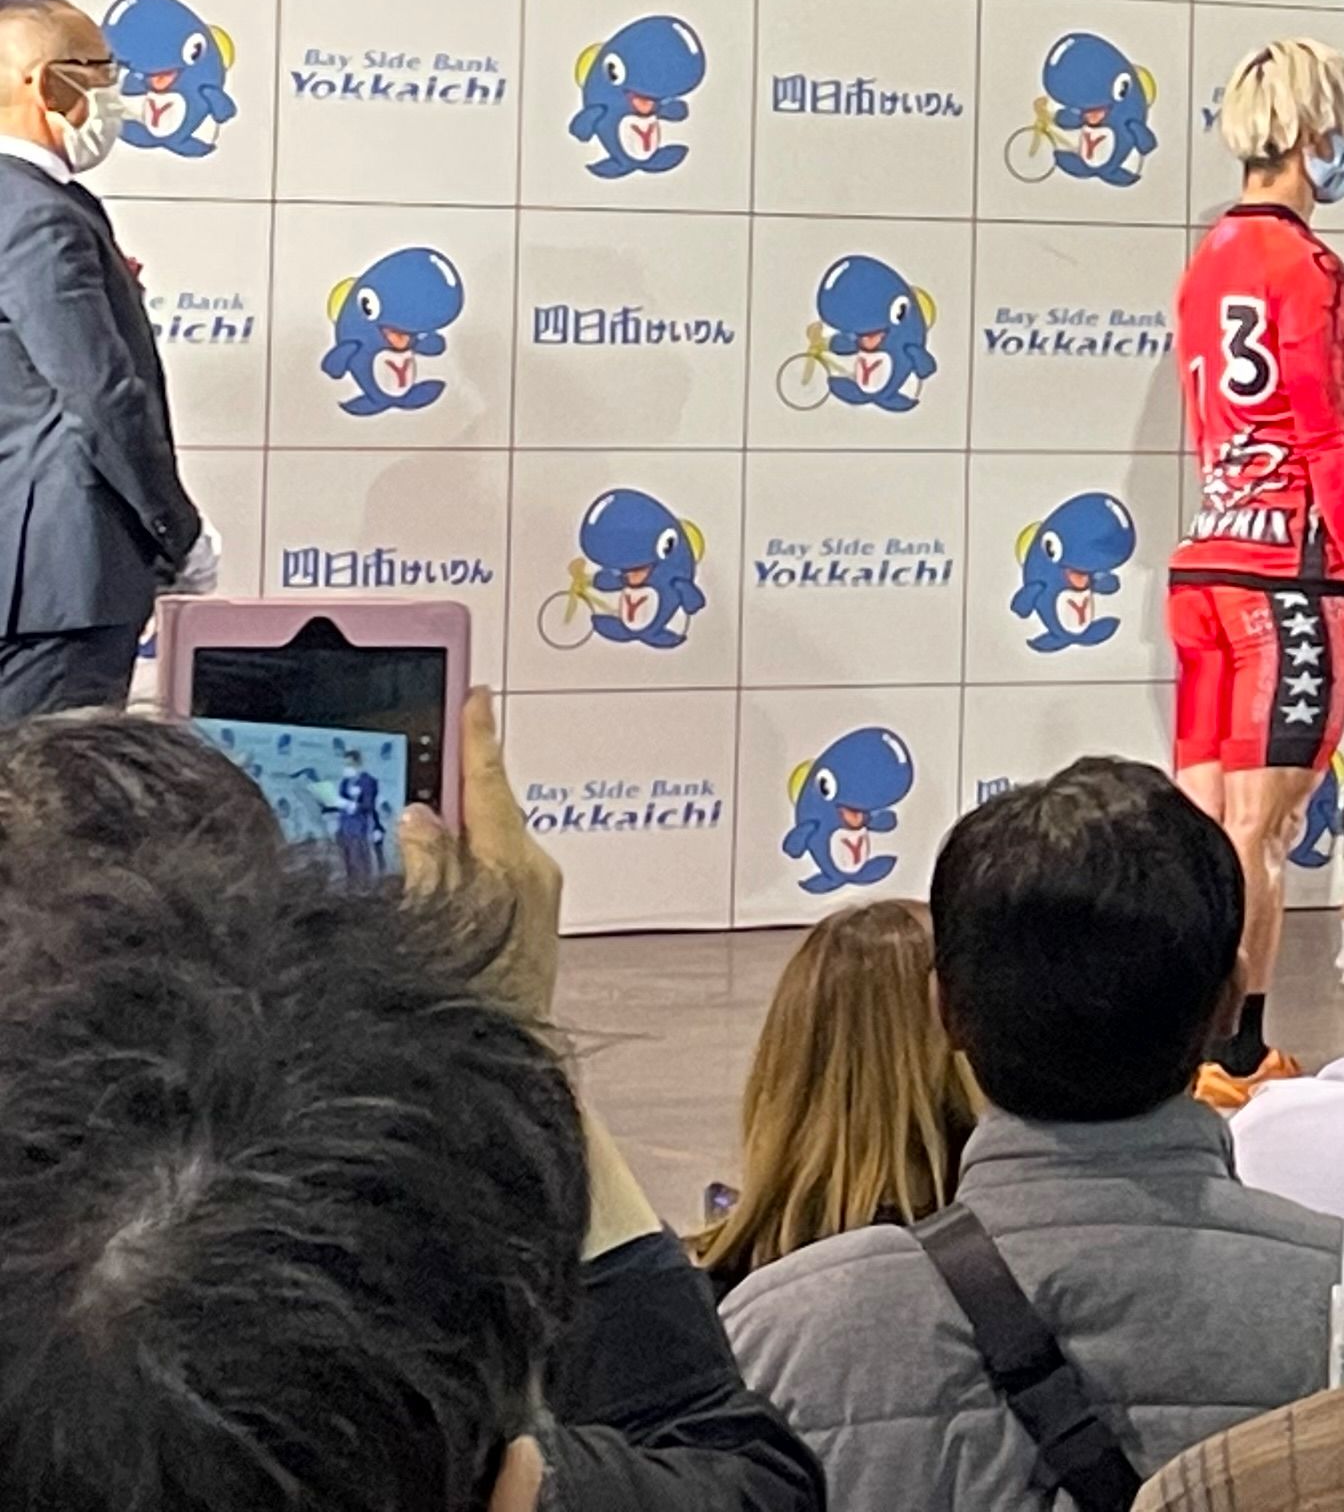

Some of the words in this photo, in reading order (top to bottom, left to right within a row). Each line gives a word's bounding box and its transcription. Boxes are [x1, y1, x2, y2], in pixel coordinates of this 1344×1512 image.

[303, 48, 352, 69] Bay
[363, 49, 422, 71] Side
[432, 52, 499, 74] Bank
[291, 68, 506, 105] Yokkaichi
[773, 74, 963, 117] 四日市けいりん
[150, 99, 172, 127] Y
[631, 124, 655, 152] Y
[1084, 132, 1105, 159] Y
[176, 293, 244, 310] Bank
[533, 305, 735, 345] 四日市けいりん
[994, 307, 1039, 329] Bay
[1046, 307, 1100, 327] Side
[1108, 308, 1167, 328] Bank
[984, 327, 1174, 357] Yokkaichi
[1221, 296, 1278, 405] 3
[386, 358, 410, 387] Y
[859, 357, 882, 385] Y
[765, 538, 812, 560] Bay
[819, 537, 875, 557] Side
[884, 537, 945, 556] Bank
[283, 547, 493, 588] 四日市けいりん
[754, 559, 953, 588] Yokkaichi
[625, 594, 647, 621] Y
[1068, 597, 1088, 625] Y
[526, 784, 569, 805] Bay
[582, 780, 640, 799] Side
[651, 779, 714, 798] Bank
[842, 837, 863, 864] Y
